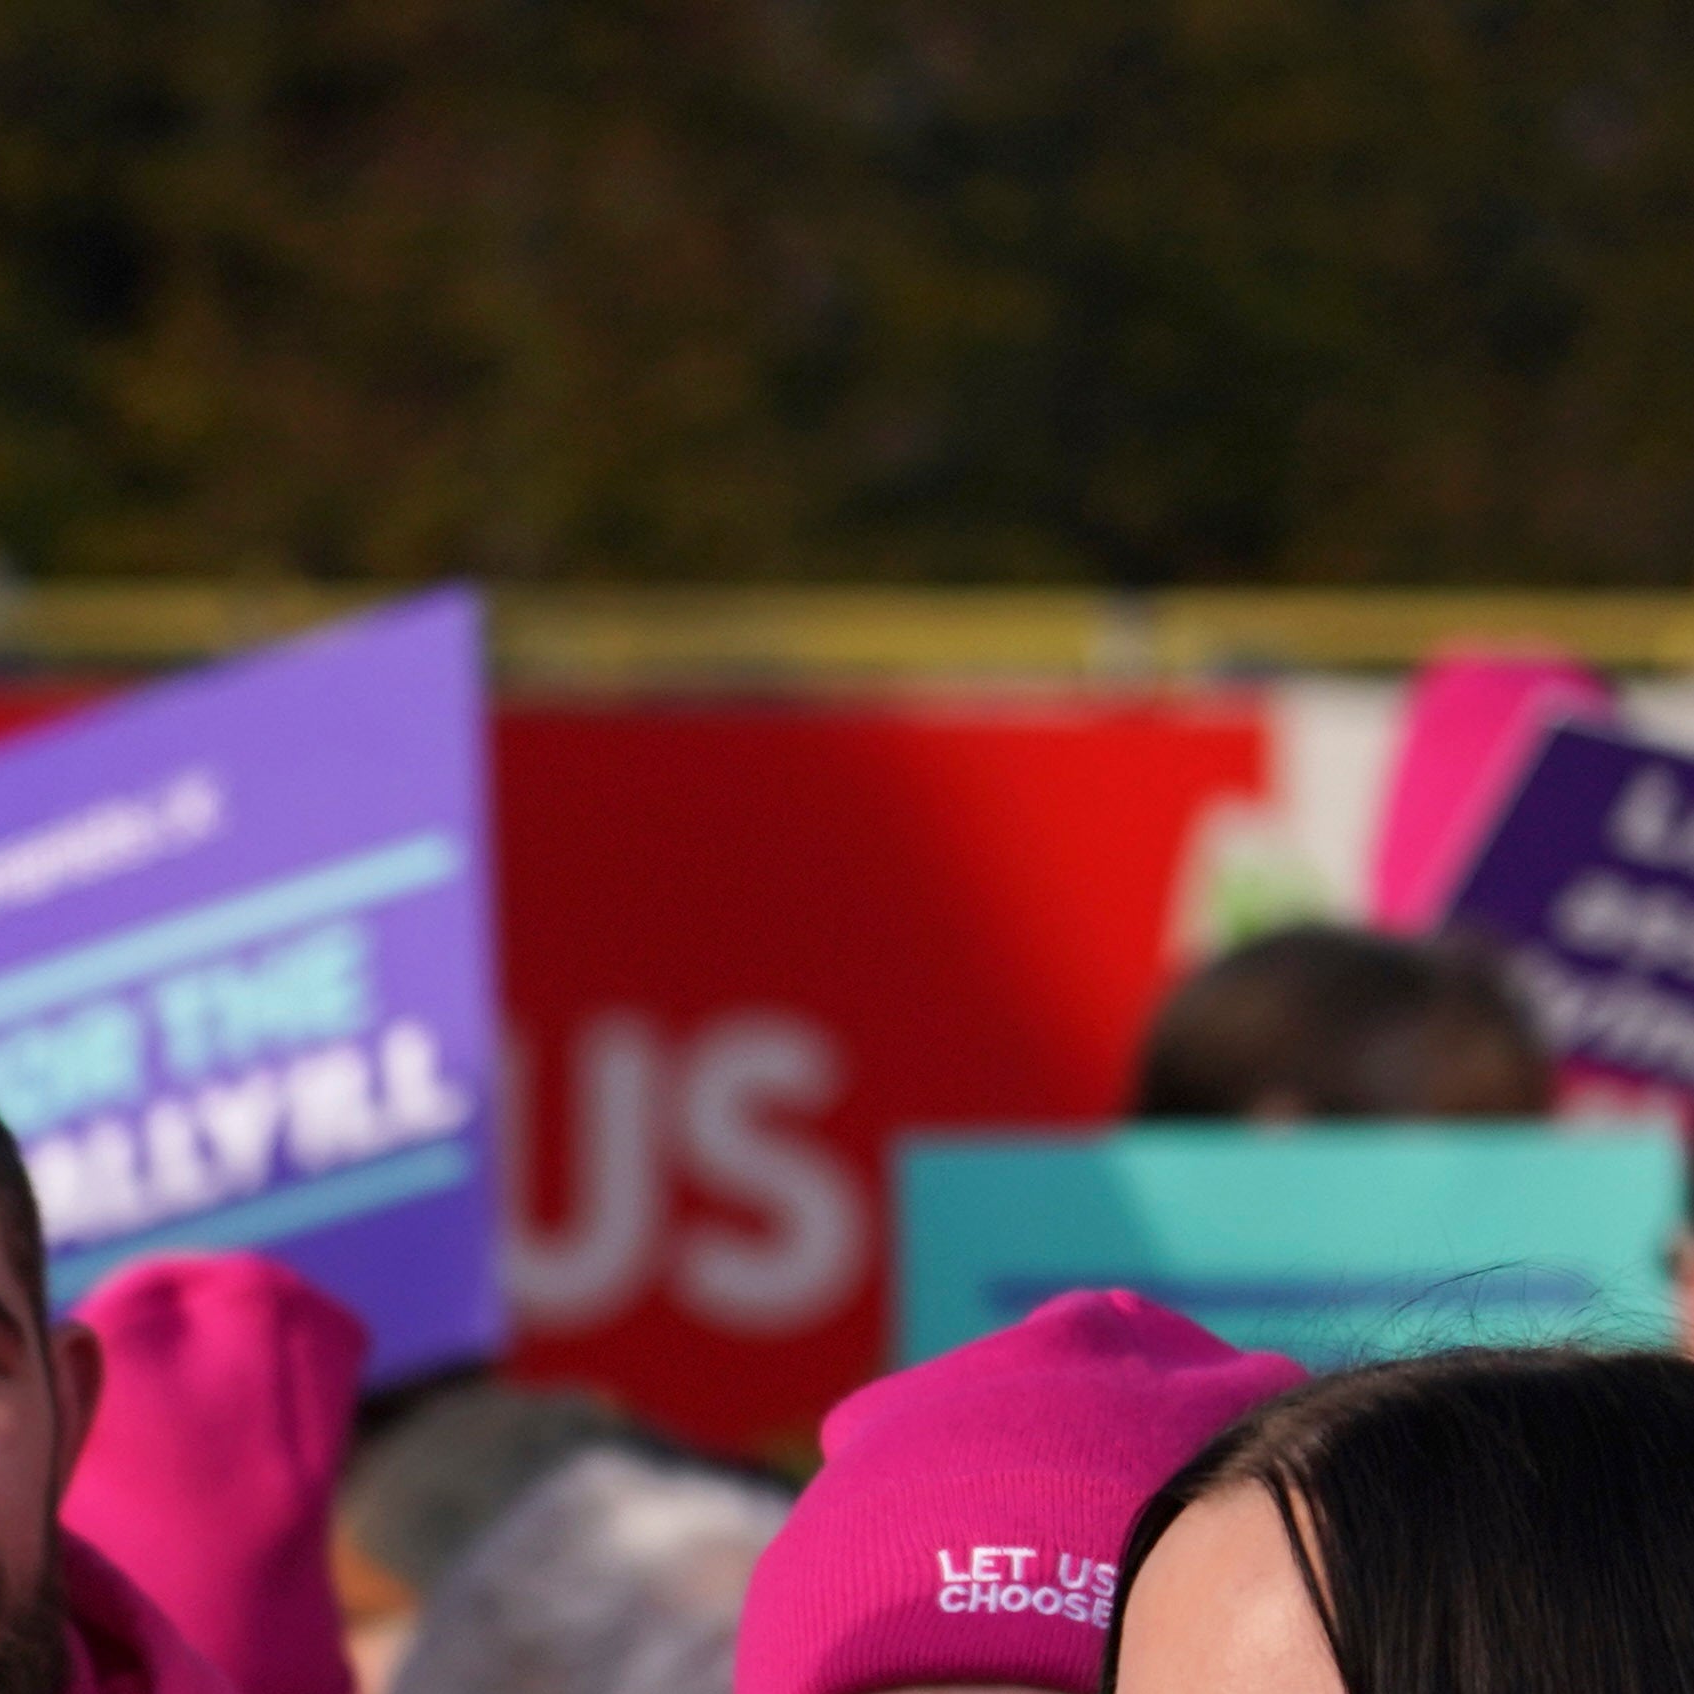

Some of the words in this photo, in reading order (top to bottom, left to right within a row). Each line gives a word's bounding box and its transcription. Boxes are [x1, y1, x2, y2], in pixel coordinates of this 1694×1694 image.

[938, 1545, 1038, 1583] LET
[1058, 1552, 1119, 1598] US
[938, 1582, 1114, 1630] CHOOSE
